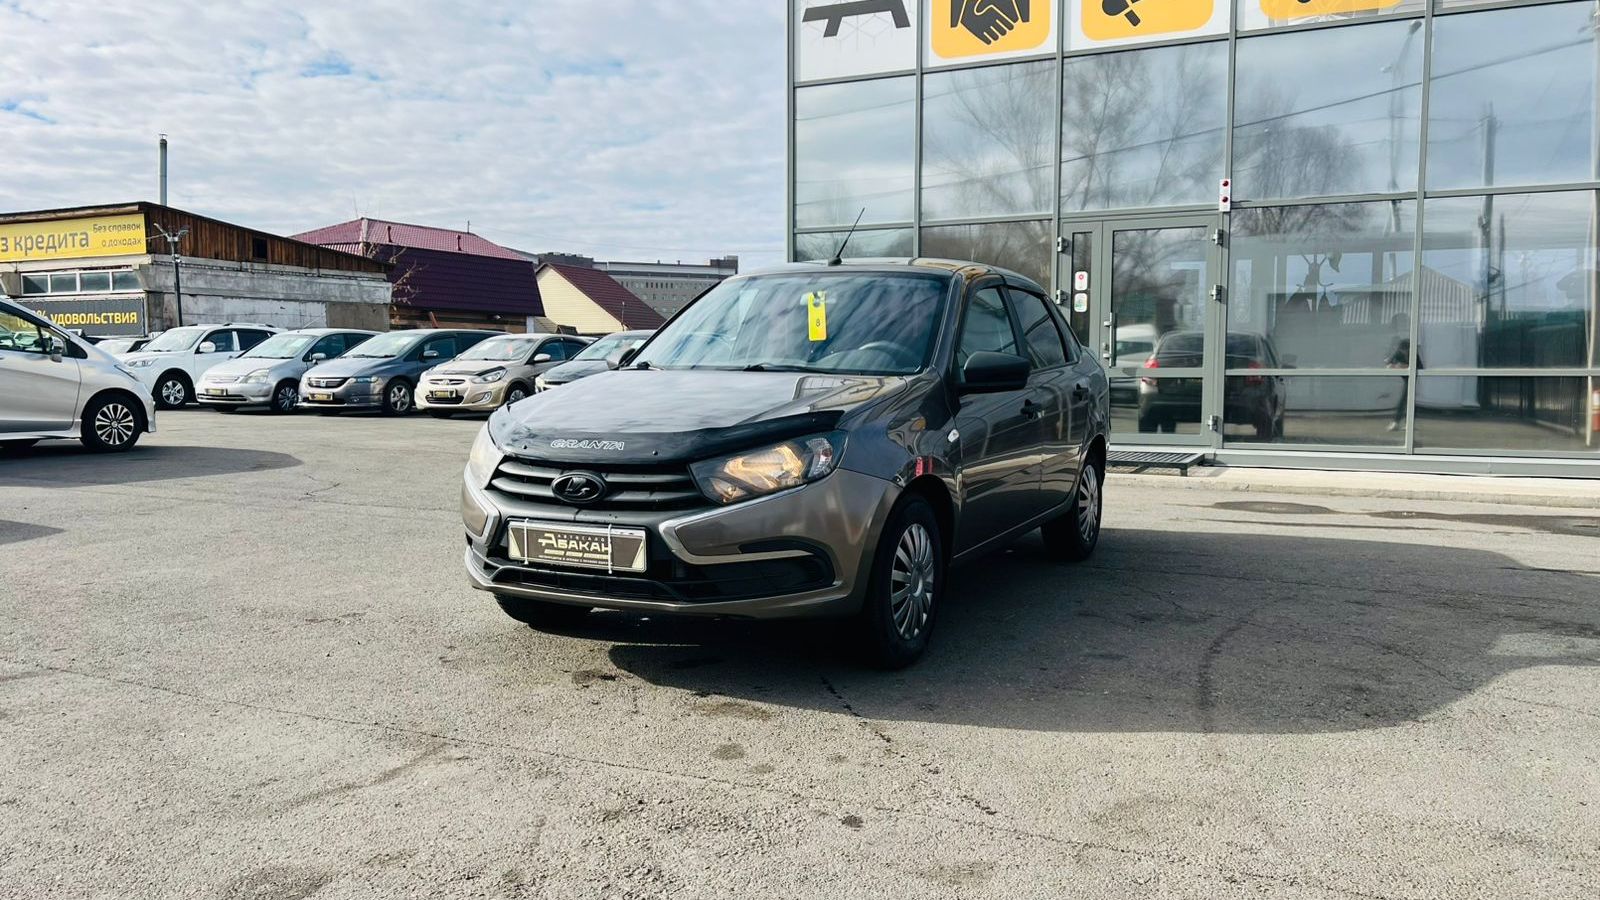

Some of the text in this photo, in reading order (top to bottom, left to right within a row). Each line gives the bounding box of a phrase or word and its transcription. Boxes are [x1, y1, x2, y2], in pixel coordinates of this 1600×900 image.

[92, 223, 141, 233] Без справок
[14, 231, 89, 256] кредита
[101, 239, 142, 248] о доходах
[550, 439, 625, 450] GRANTA
